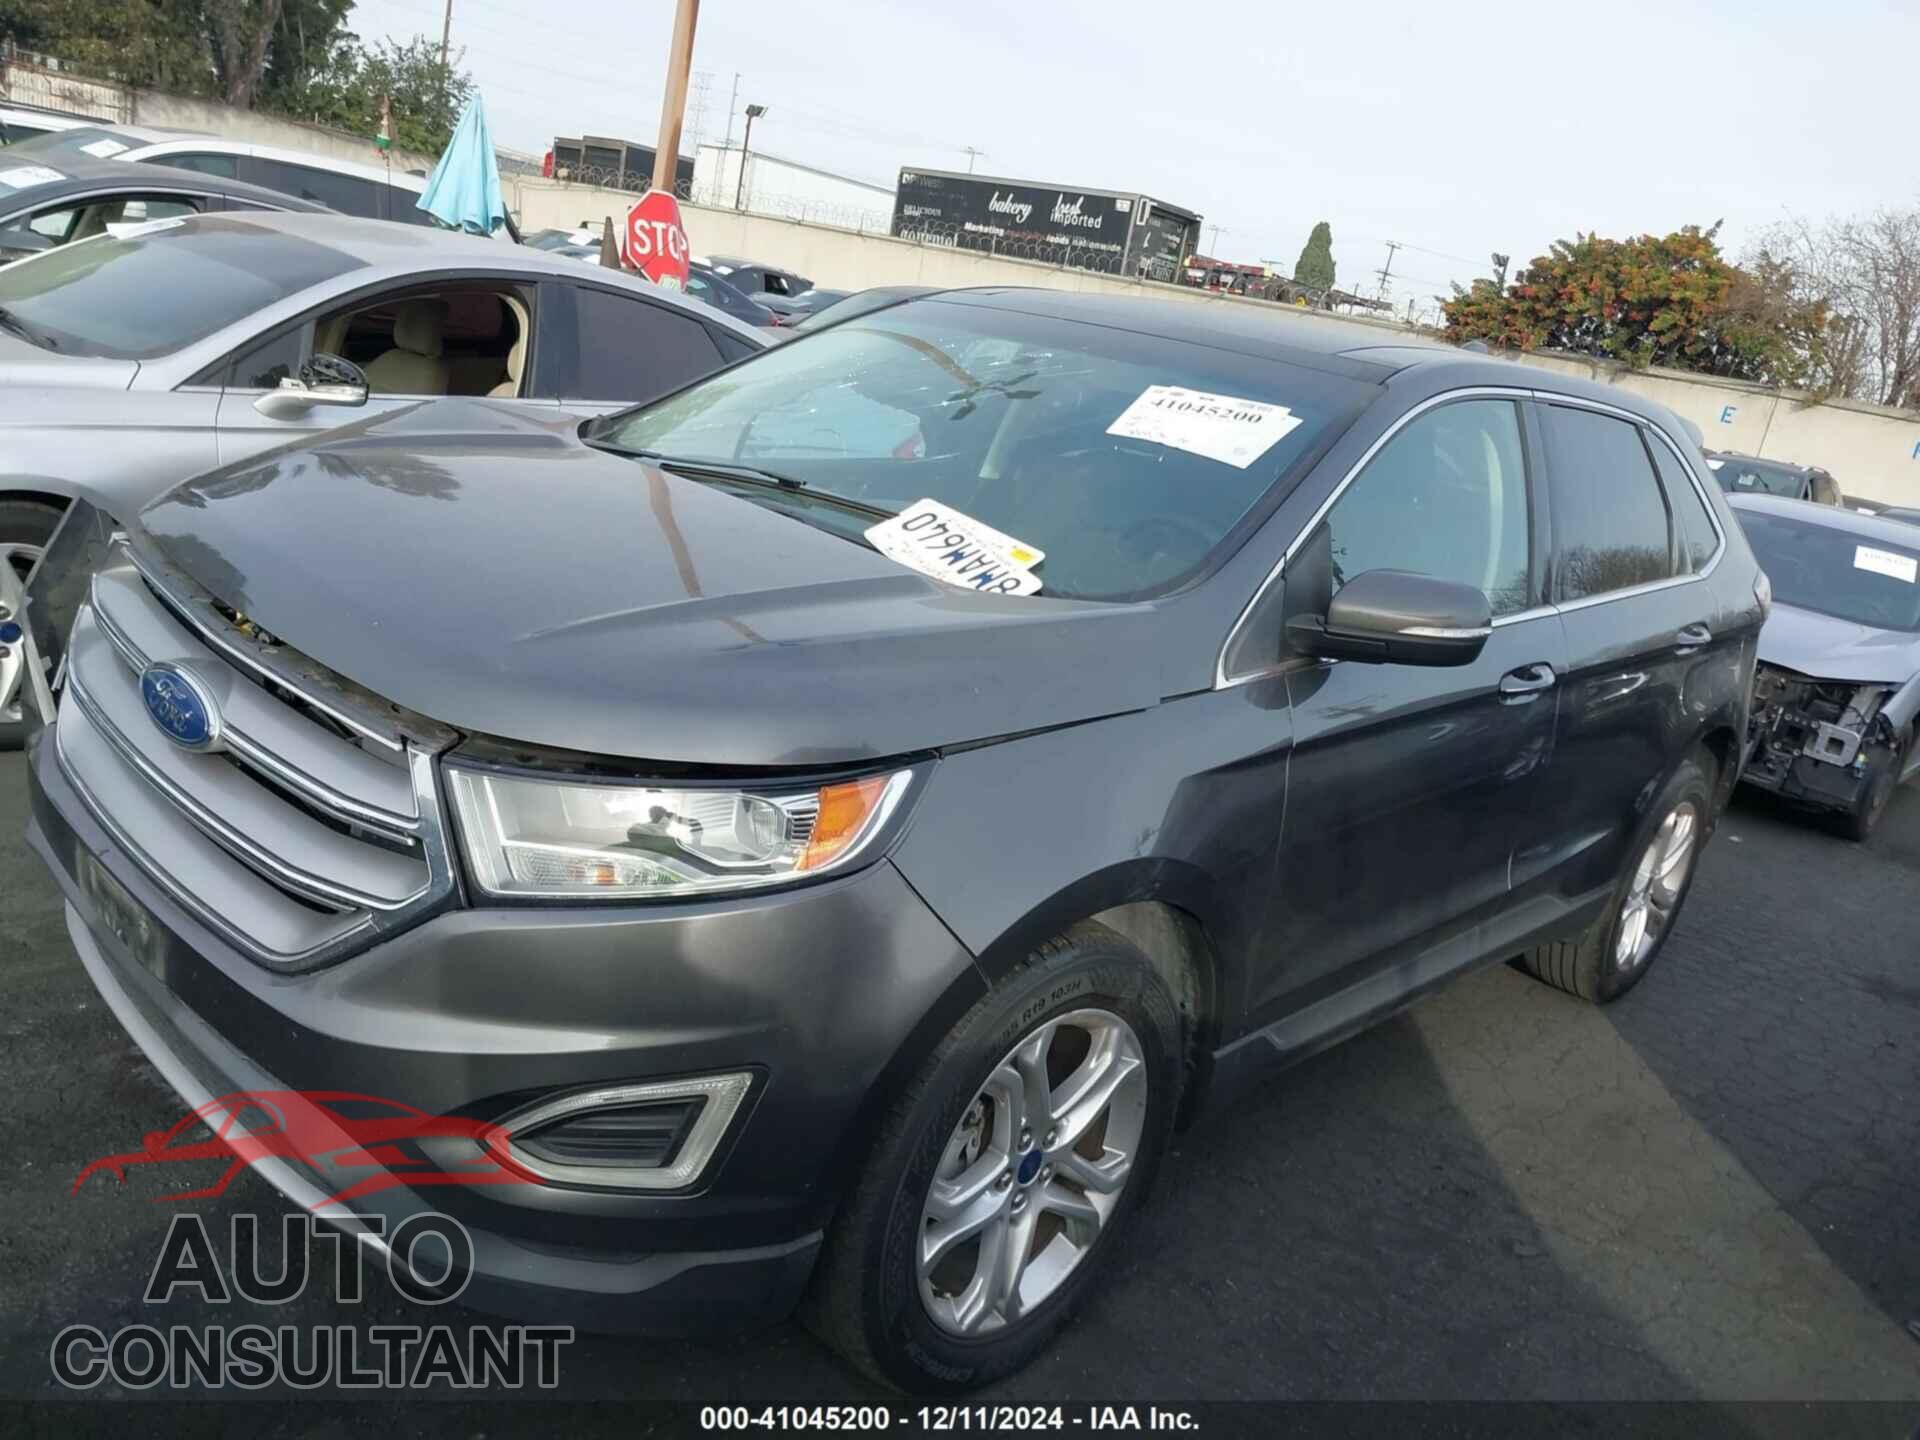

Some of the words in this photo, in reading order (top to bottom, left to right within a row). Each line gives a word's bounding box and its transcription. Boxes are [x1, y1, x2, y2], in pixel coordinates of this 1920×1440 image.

[988, 191, 1032, 224] bakery
[1050, 208, 1103, 229] imported
[633, 218, 688, 262] STOP
[1151, 397, 1263, 424] 41045200
[1720, 406, 1737, 424] E
